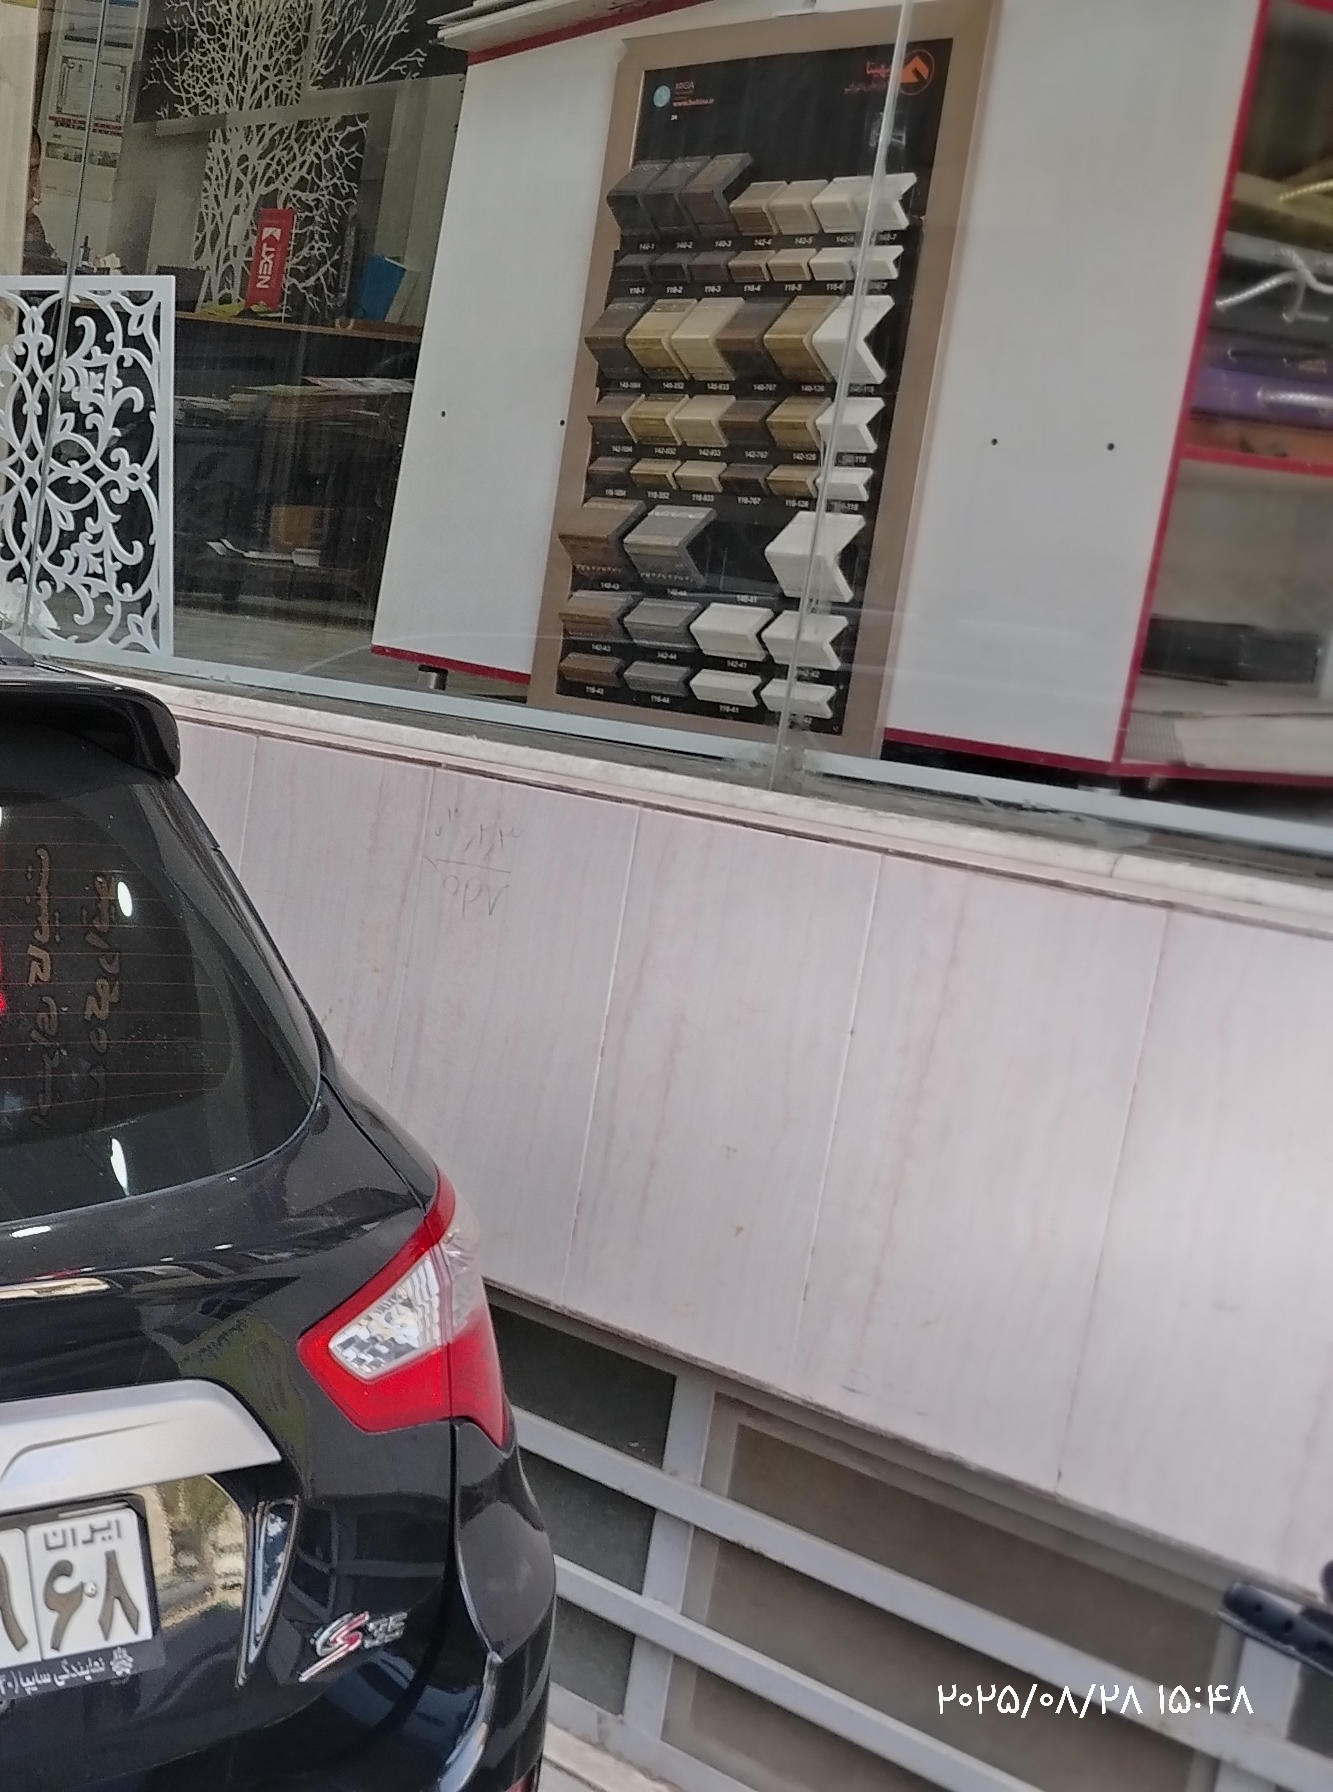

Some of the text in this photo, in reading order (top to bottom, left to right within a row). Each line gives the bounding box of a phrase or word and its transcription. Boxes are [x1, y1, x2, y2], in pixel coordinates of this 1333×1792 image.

[255, 245, 277, 290] NEXT
[44, 1517, 122, 1551] ایران
[43, 1549, 140, 1652] ۶۸
